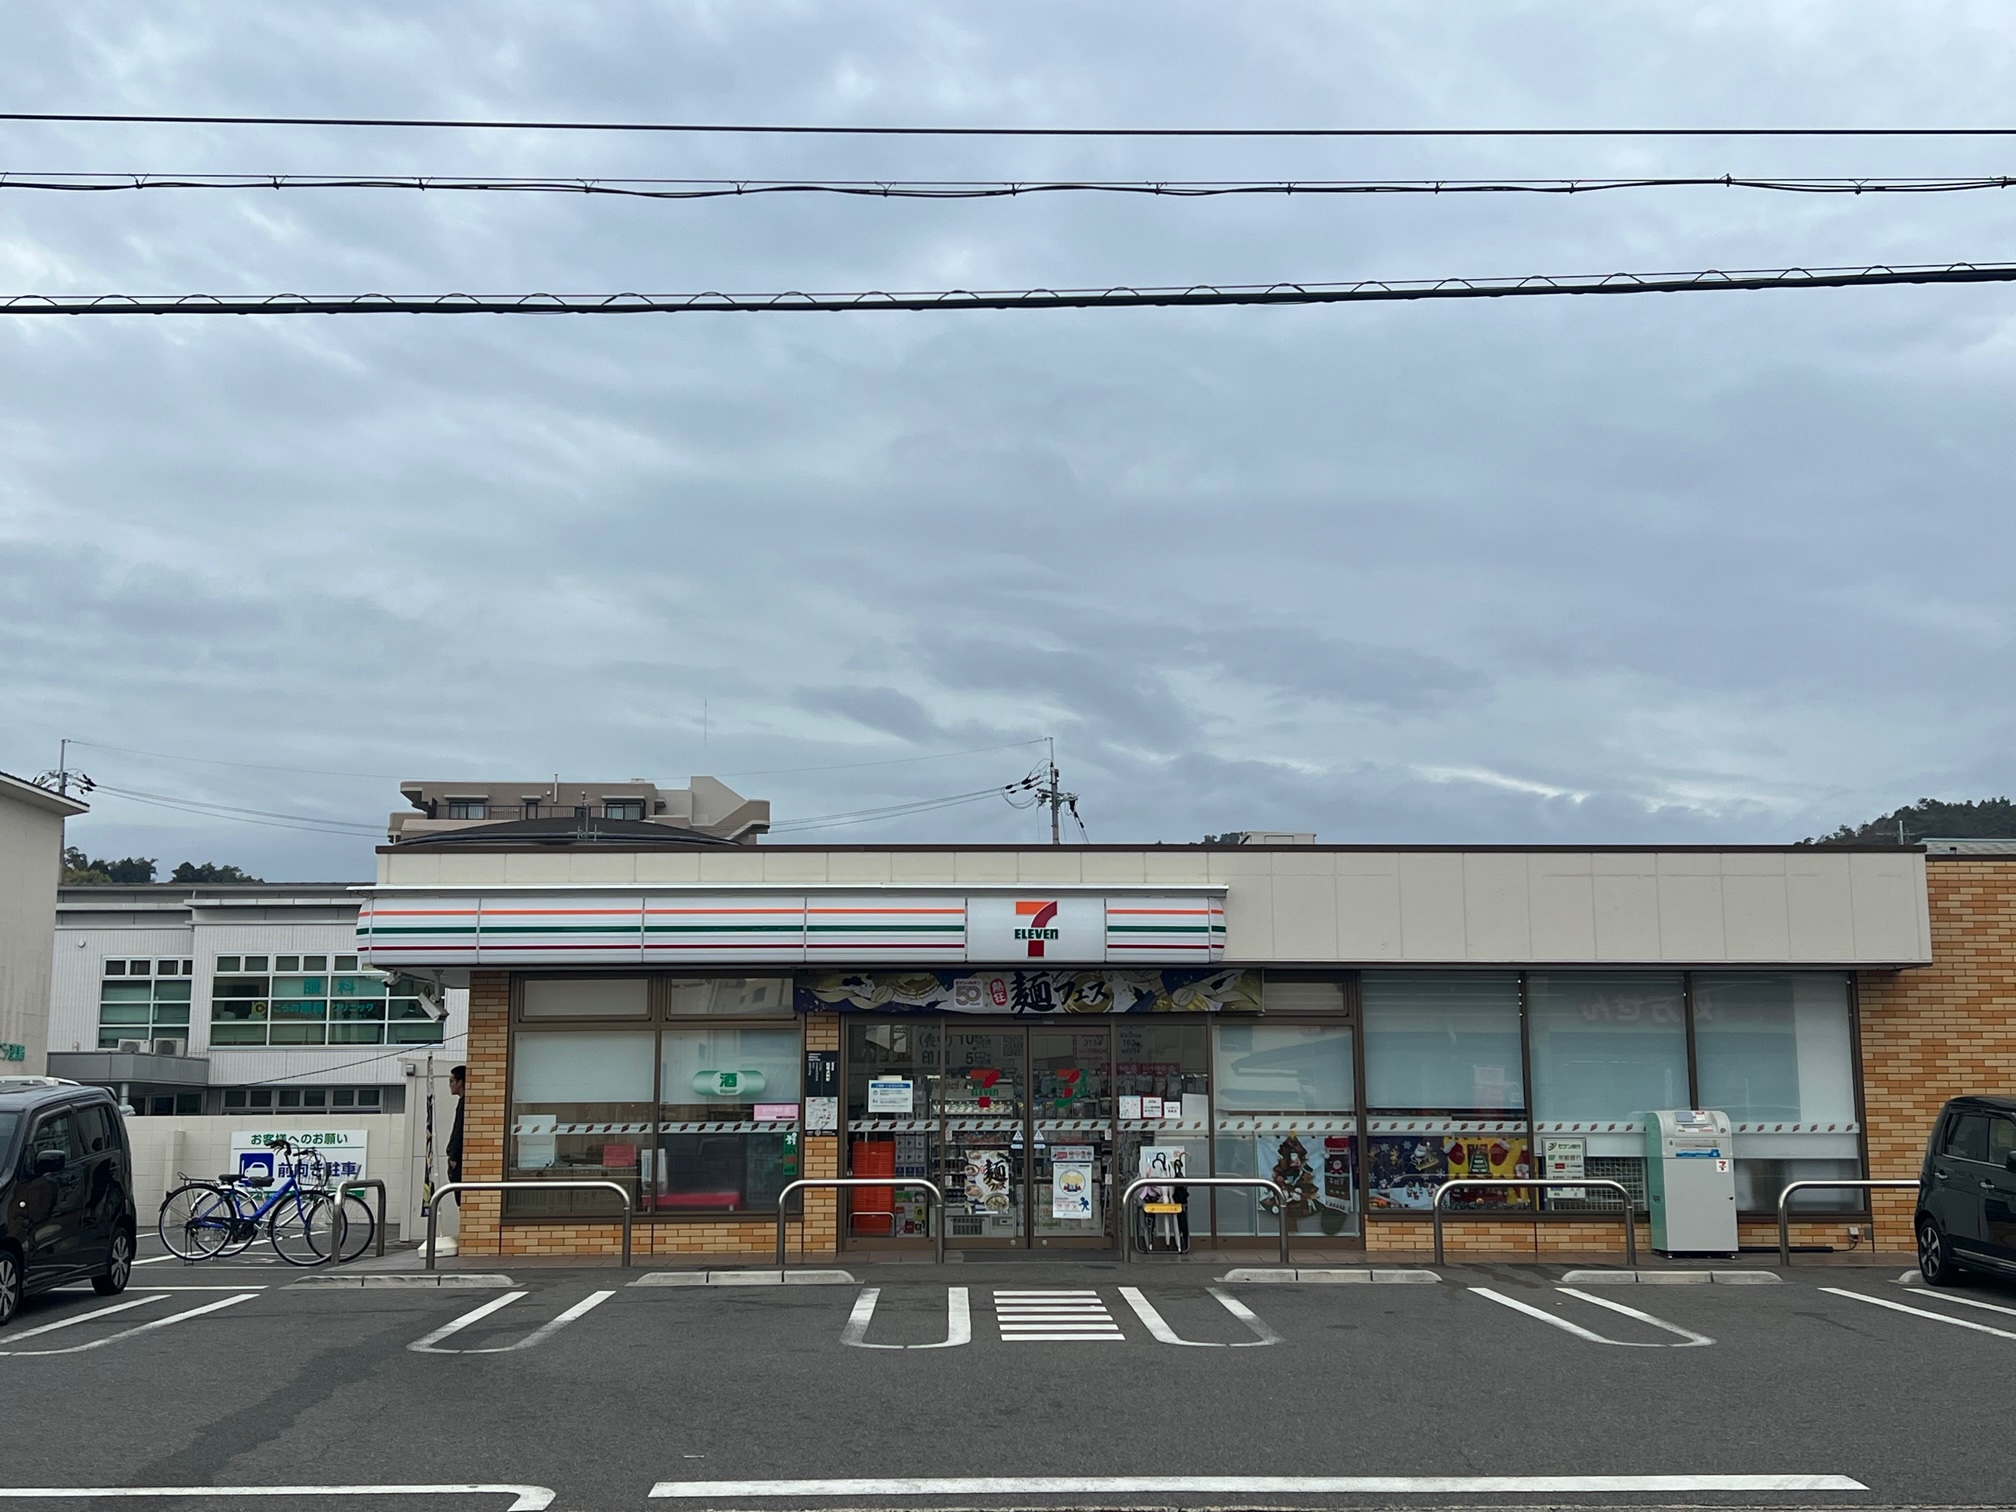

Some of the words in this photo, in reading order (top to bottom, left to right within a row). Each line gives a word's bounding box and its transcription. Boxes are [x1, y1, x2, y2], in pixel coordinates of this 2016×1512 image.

[1015, 900, 1058, 958] 7
[719, 1072, 738, 1087] 酒
[250, 1132, 348, 1146] お客様へのお願い
